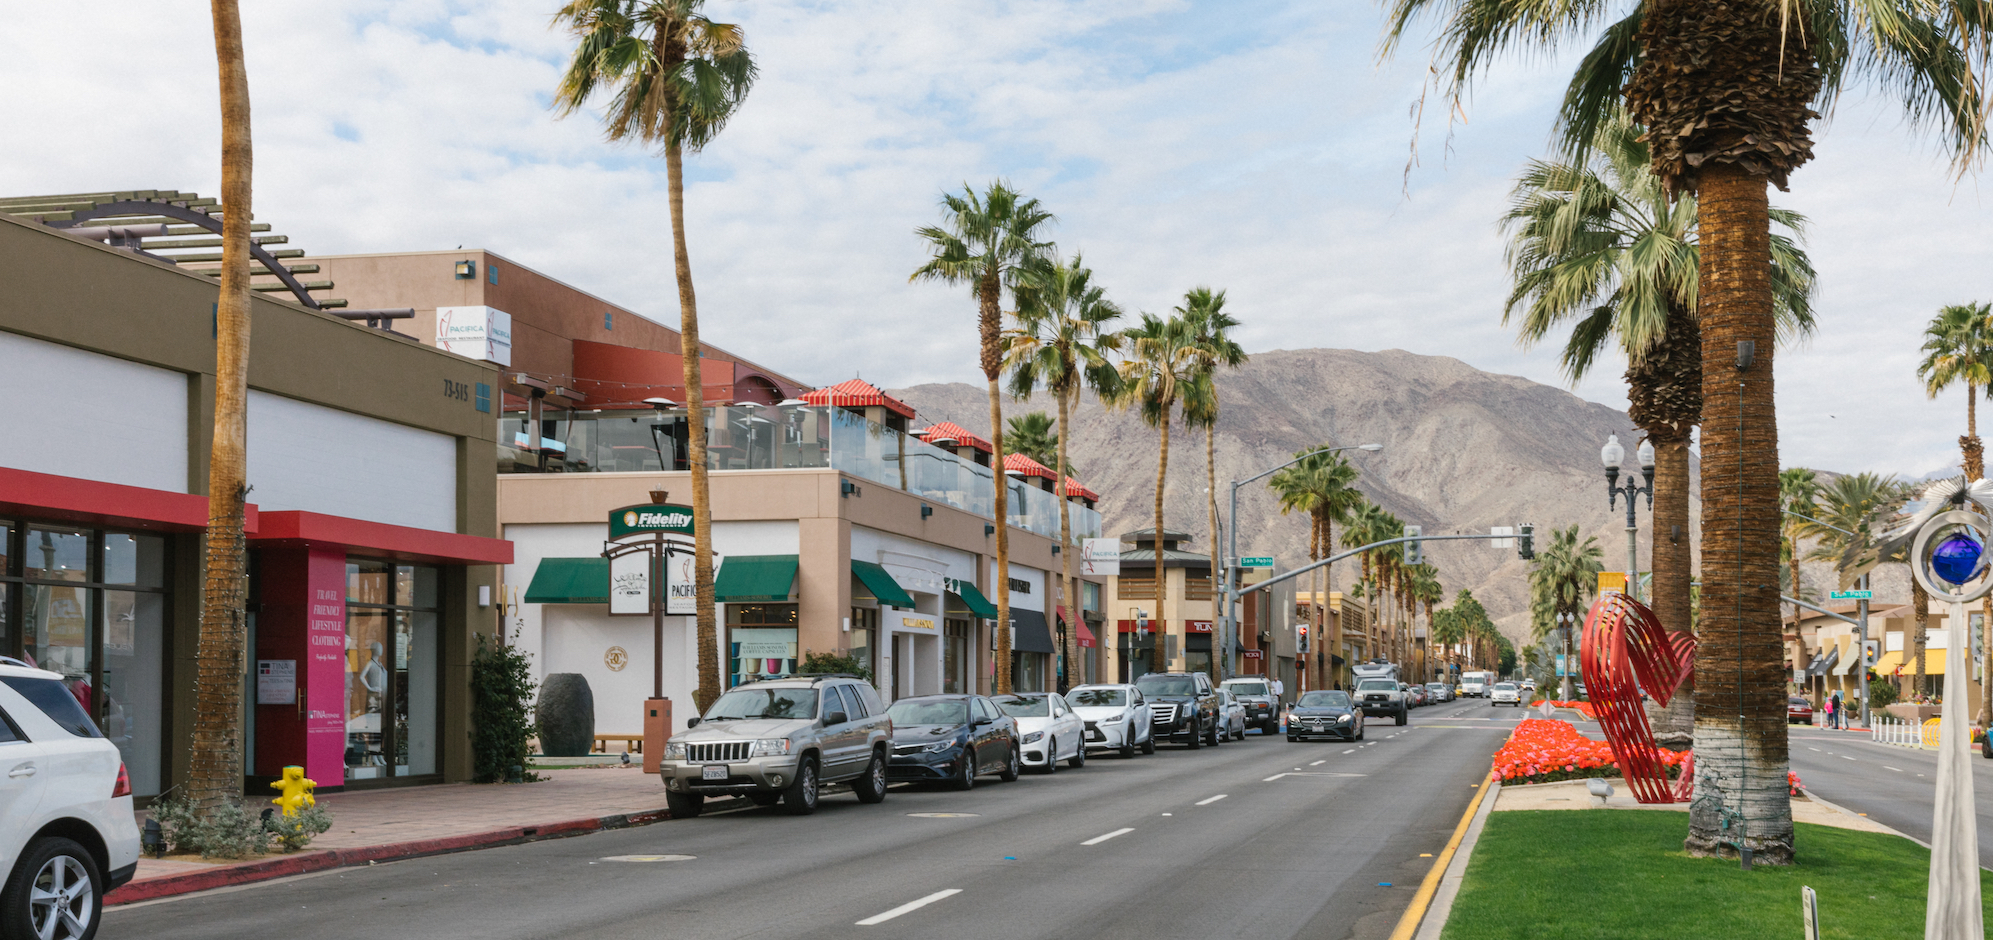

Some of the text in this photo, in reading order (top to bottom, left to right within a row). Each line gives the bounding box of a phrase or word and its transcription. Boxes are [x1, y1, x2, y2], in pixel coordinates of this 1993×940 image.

[449, 325, 484, 333] PACIFICA
[443, 379, 468, 402] 73-515
[638, 512, 693, 527] Fidelity
[316, 589, 338, 601] TRAVEL
[671, 584, 697, 598] PACIFIC
[313, 604, 341, 616] FRIENDLY
[311, 620, 342, 631] LIFESTYLE
[311, 635, 341, 647] CLOTHING
